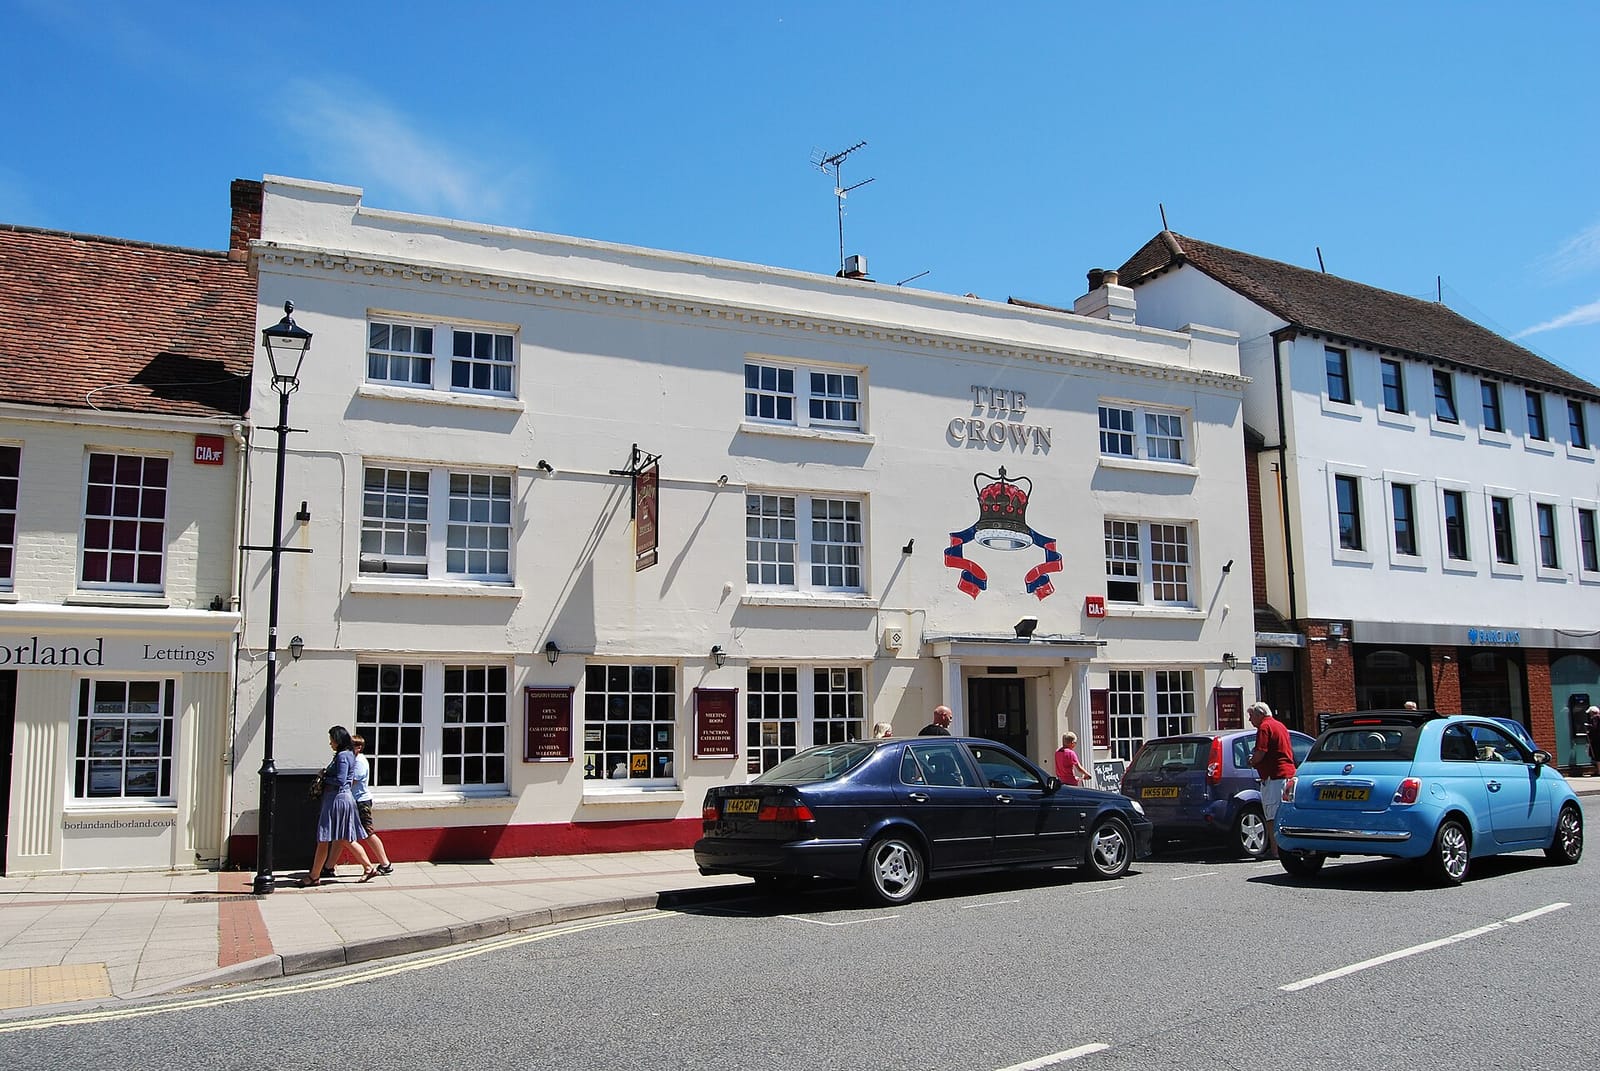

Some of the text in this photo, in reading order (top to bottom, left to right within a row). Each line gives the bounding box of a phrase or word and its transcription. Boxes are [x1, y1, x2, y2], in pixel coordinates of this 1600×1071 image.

[971, 384, 1027, 414] THE
[948, 416, 1052, 448] CROWN
[195, 446, 212, 461] CIA
[1088, 603, 1099, 615] CIA
[1480, 629, 1520, 643] BARCLAYS
[143, 644, 215, 666] Lettings
[635, 759, 646, 767] AA
[1321, 789, 1366, 800] HN14 GLZ
[64, 818, 177, 830] borlandandborland.co.uk
